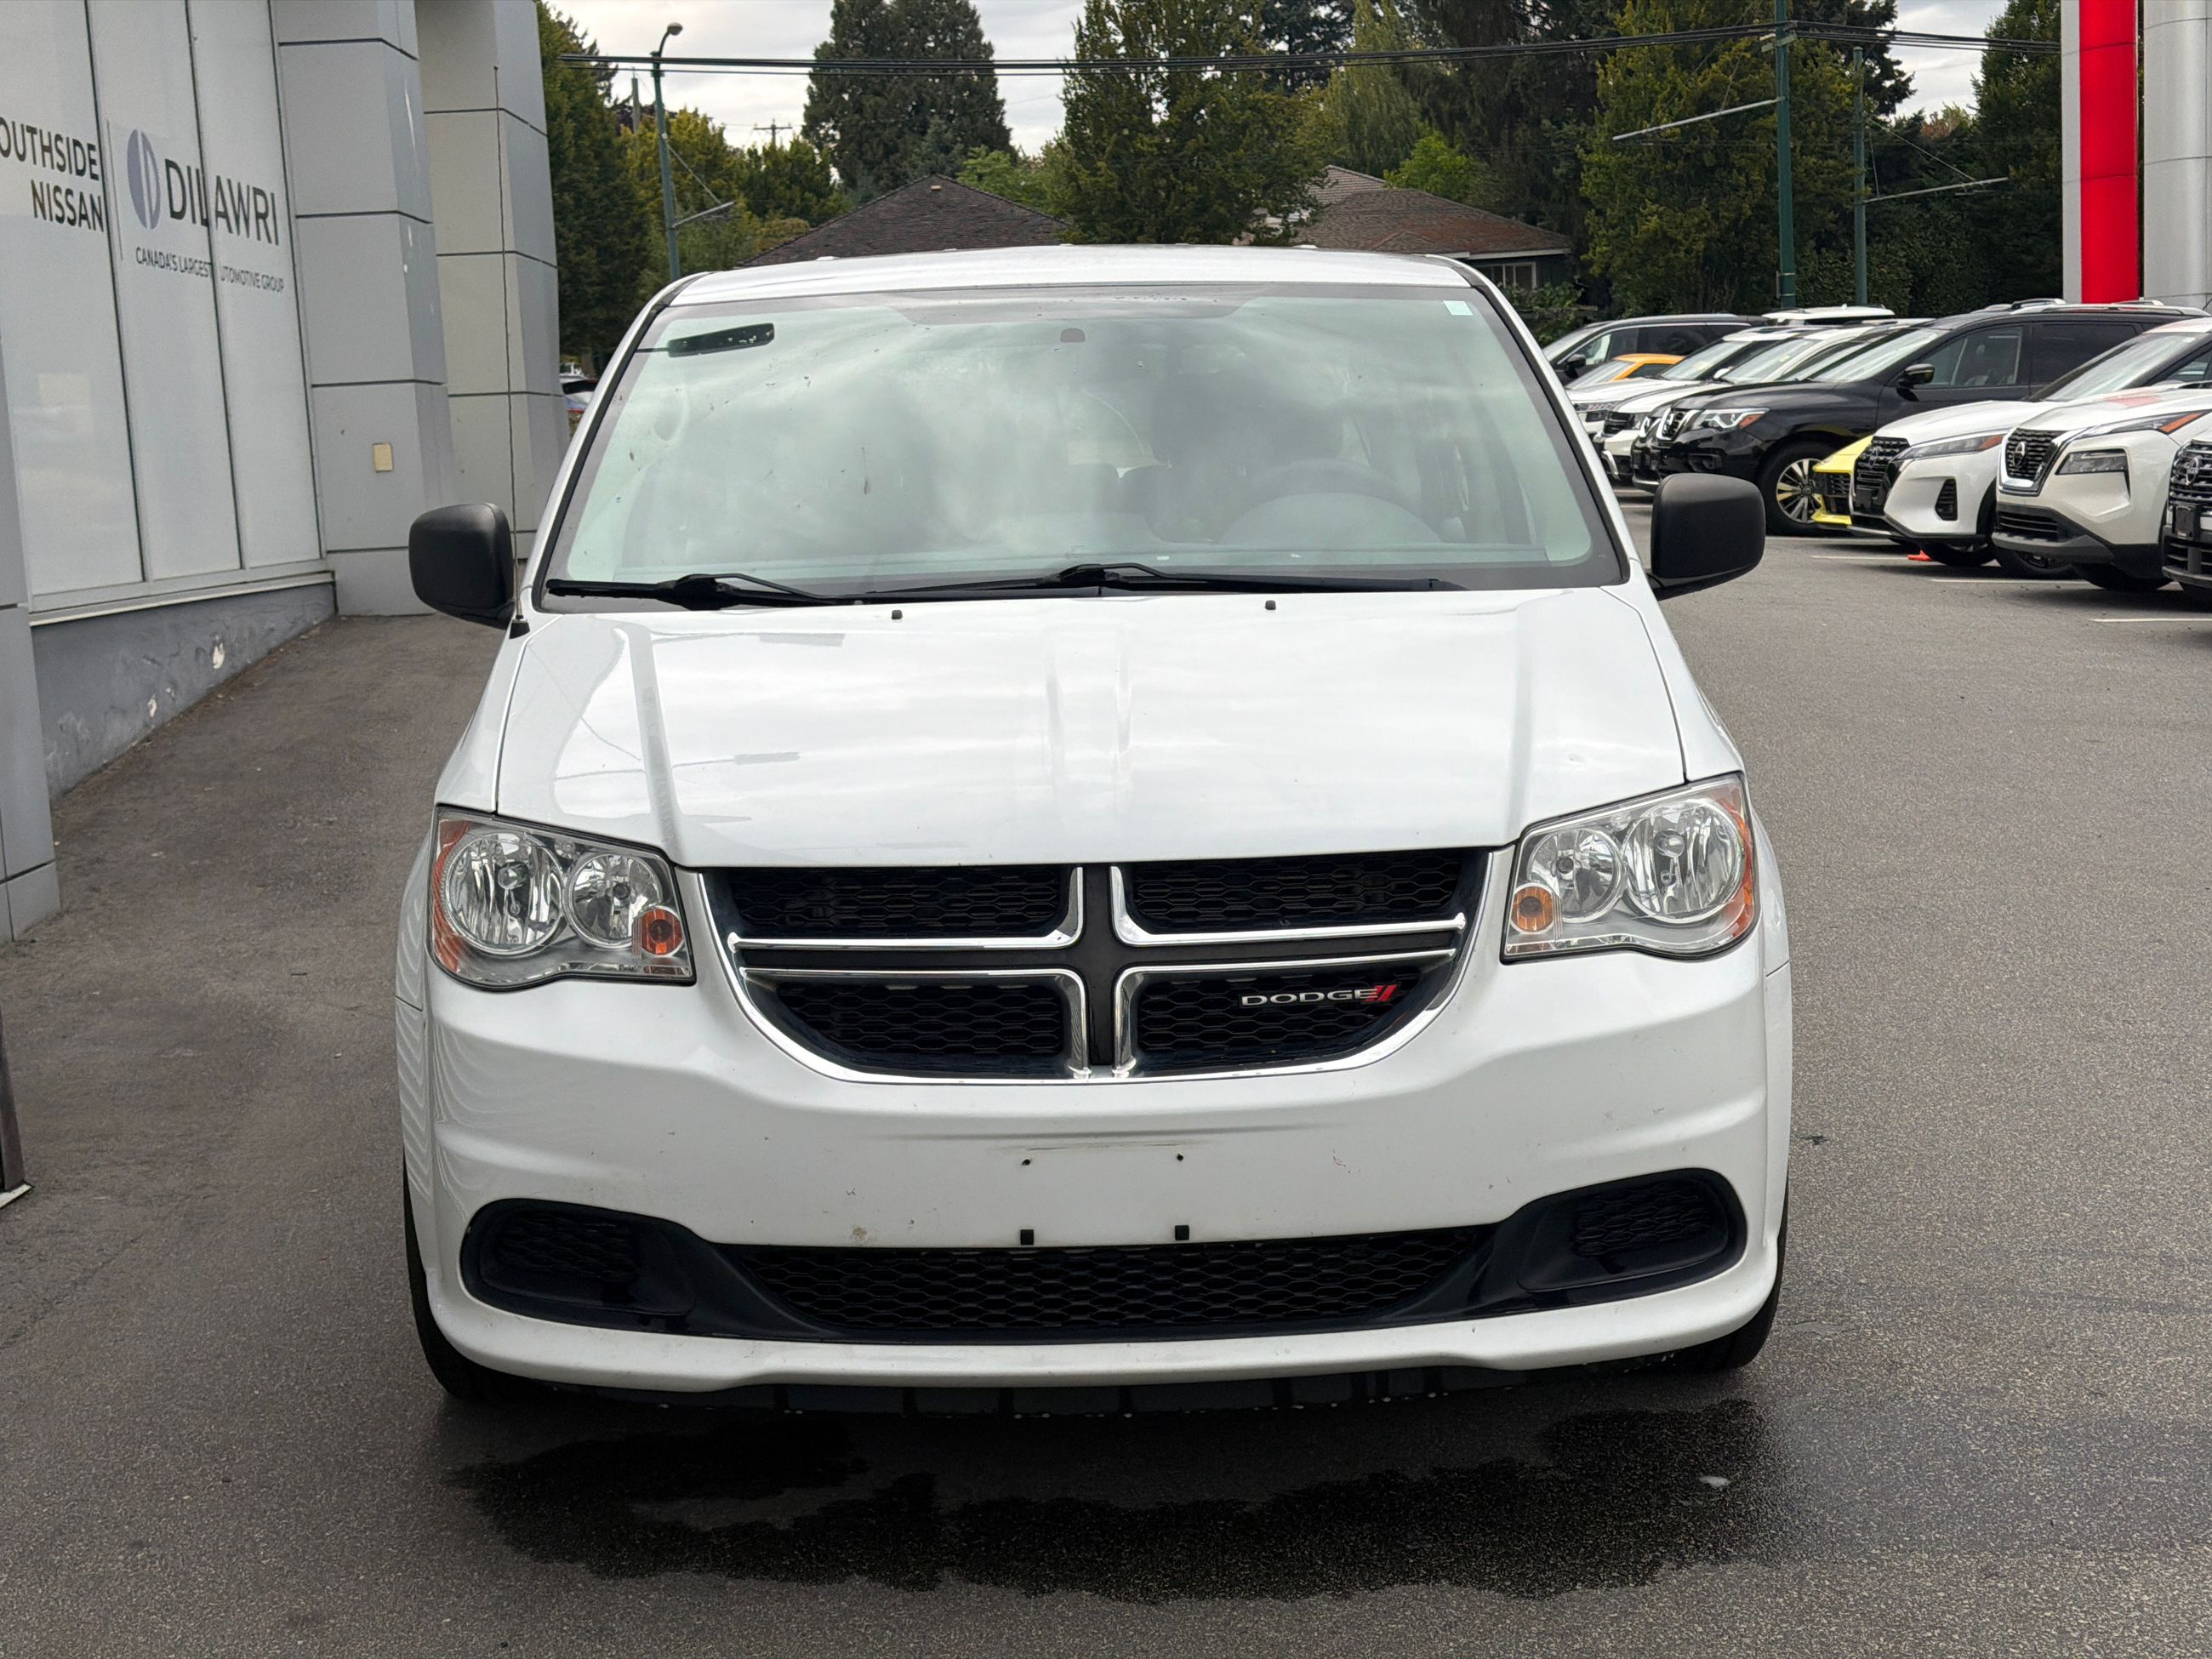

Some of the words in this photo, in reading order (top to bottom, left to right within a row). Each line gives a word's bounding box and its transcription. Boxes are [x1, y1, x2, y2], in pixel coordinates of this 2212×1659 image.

[31, 180, 104, 232] NISSAN
[165, 158, 279, 246] DILAWRI
[135, 247, 177, 271] CANADA'S
[260, 274, 285, 293] GROUP
[1241, 989, 1378, 1006] DODGE
